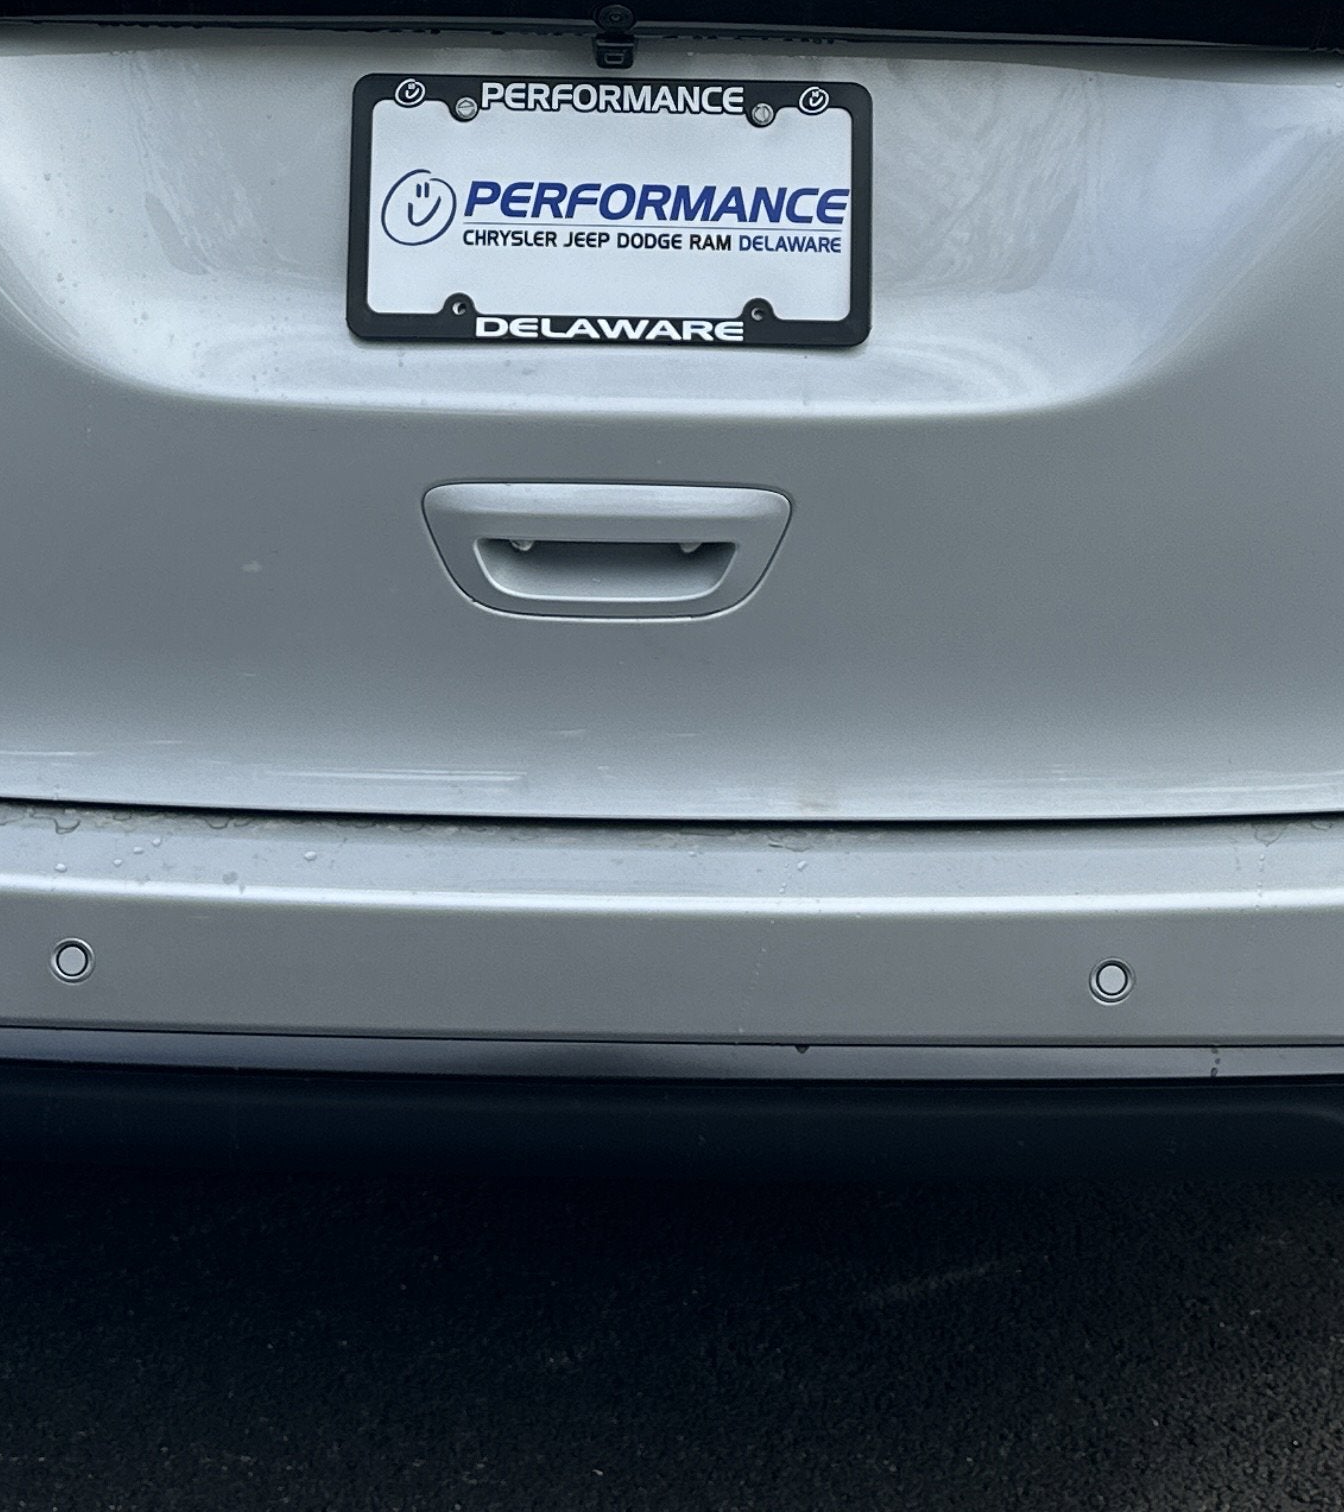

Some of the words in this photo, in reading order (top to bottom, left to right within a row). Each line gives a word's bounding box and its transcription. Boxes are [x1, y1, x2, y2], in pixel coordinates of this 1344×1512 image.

[480, 81, 745, 115] PERFORMANCE
[463, 180, 850, 225] PERFORMANCE
[462, 229, 558, 248] CHRYSLER
[563, 231, 611, 249] JEEP
[617, 232, 683, 251] DODGE
[689, 233, 732, 251] RAM
[739, 235, 842, 254] DELAWARE
[475, 316, 745, 342] DELAWARE
